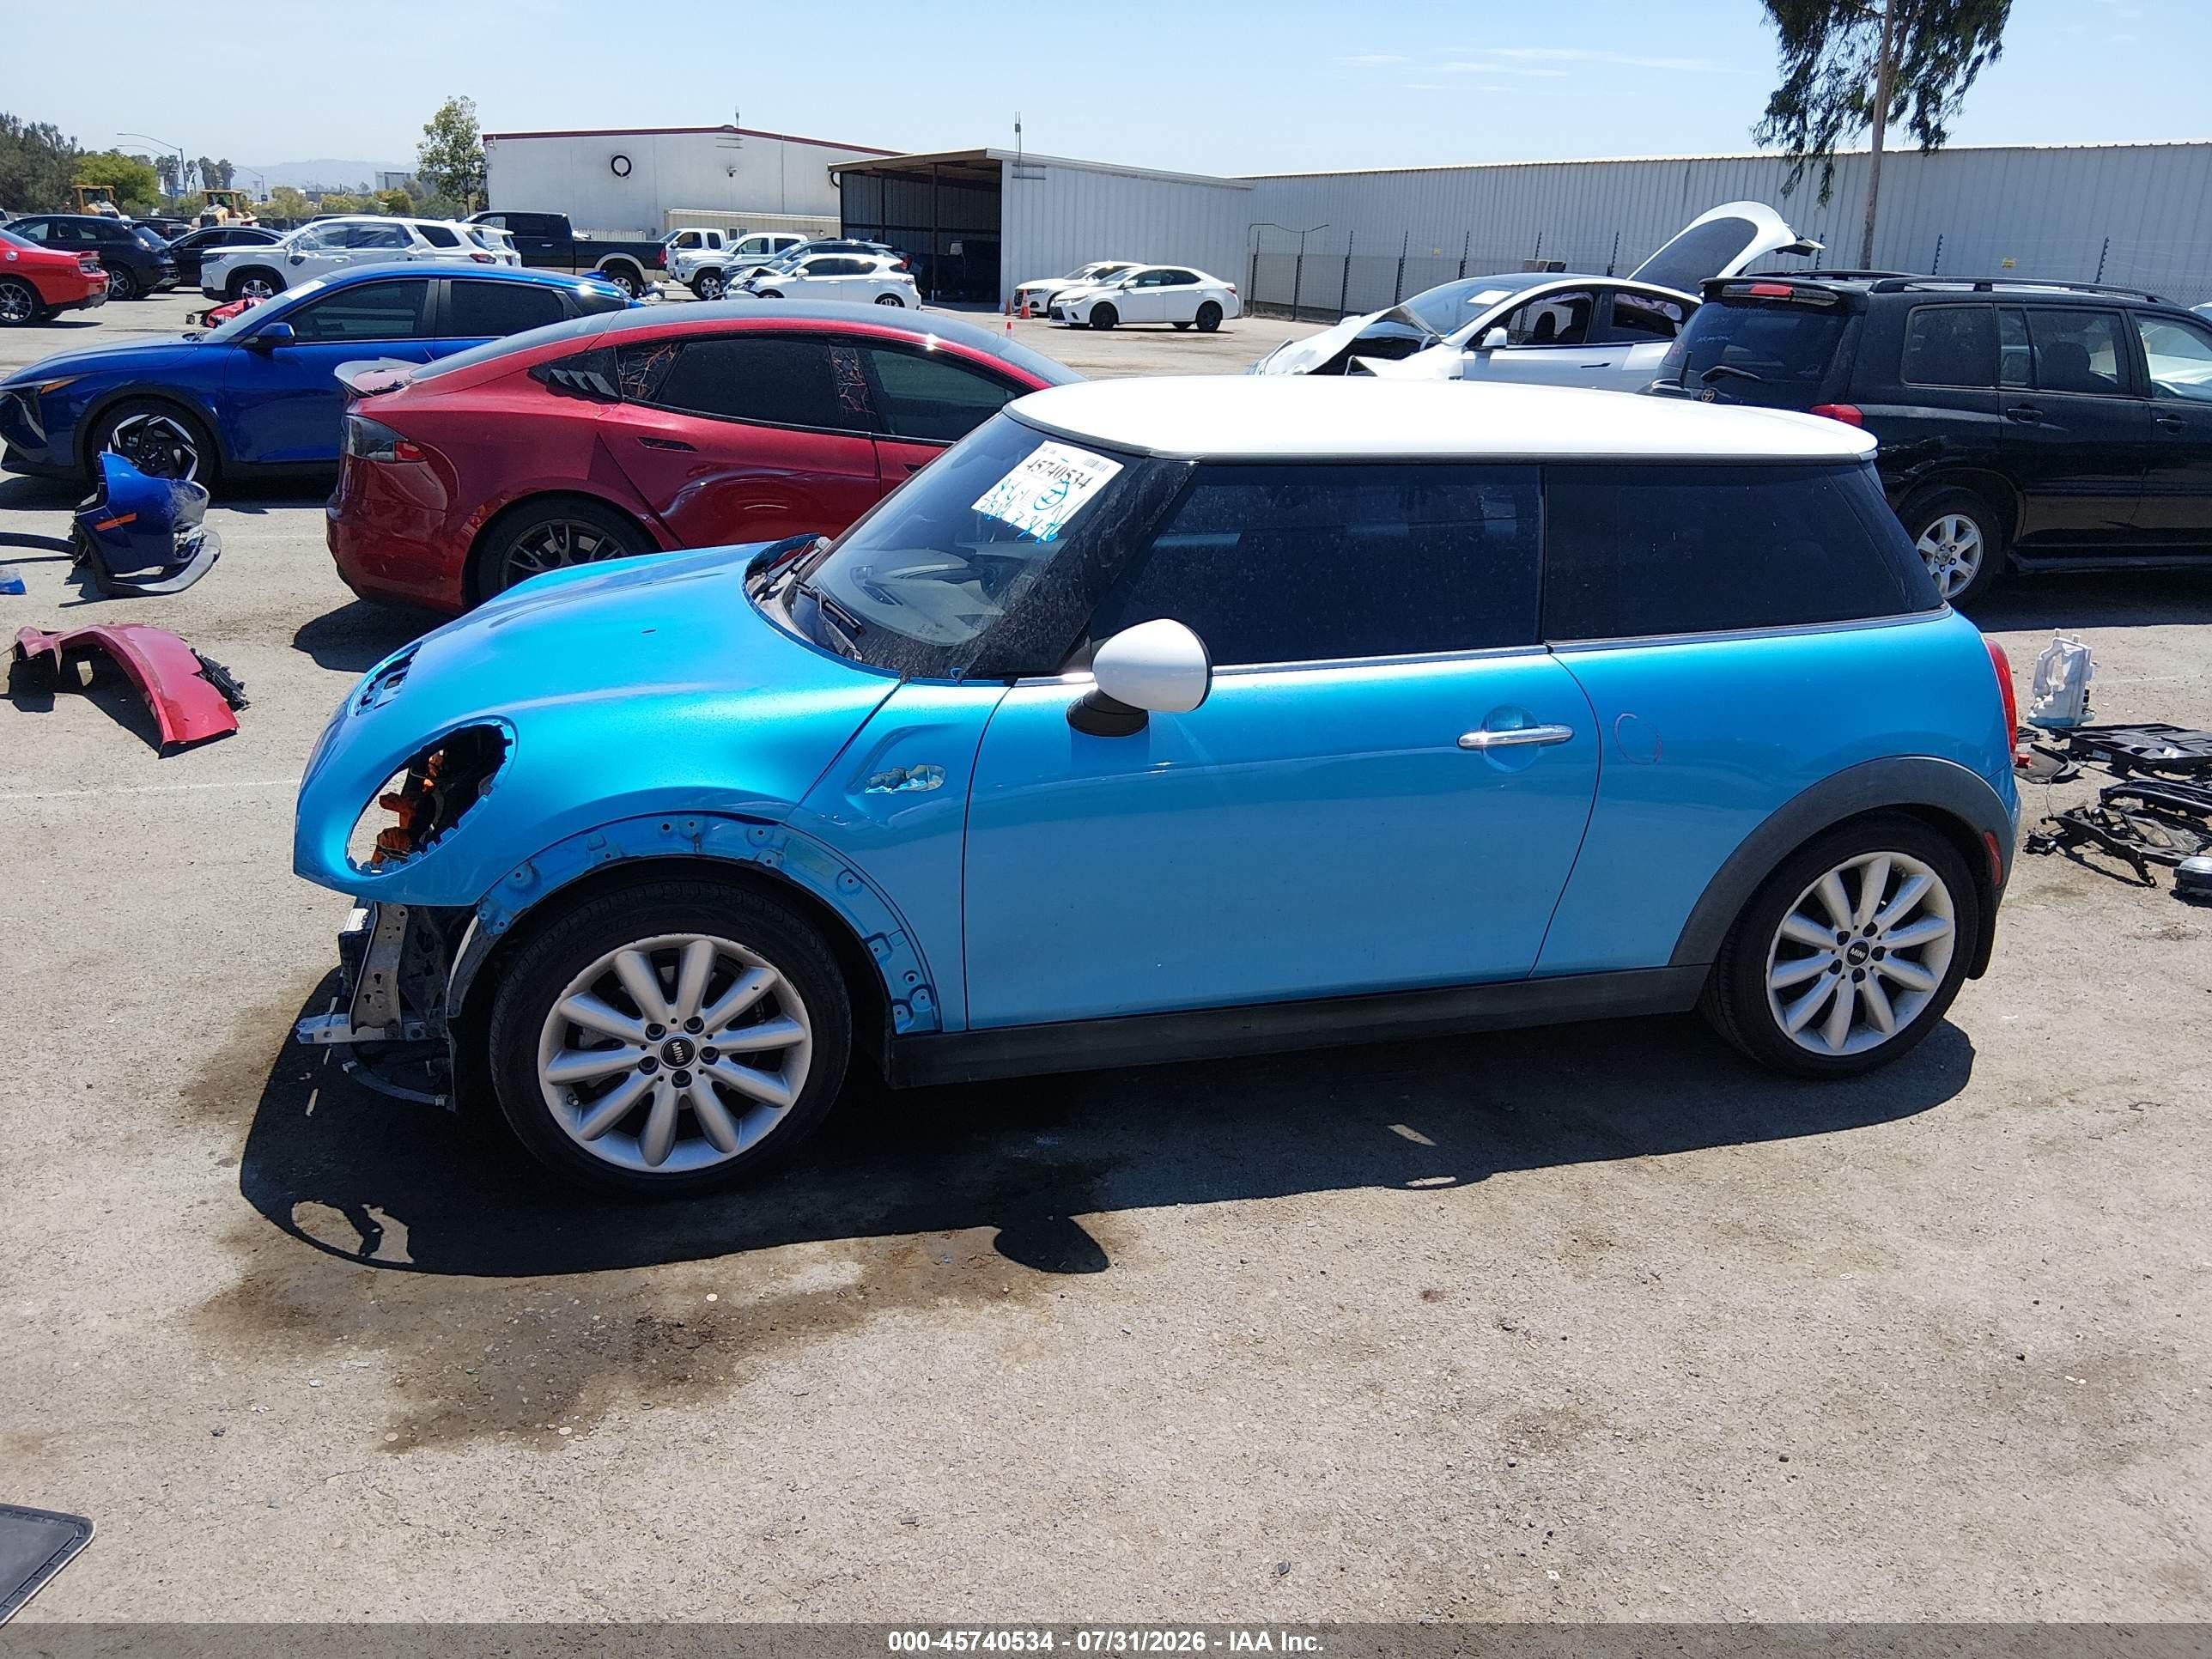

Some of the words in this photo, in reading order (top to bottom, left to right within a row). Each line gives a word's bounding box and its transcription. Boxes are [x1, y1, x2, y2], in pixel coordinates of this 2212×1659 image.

[1026, 458, 1095, 489] 45740534
[1850, 947, 1867, 960] MINI
[671, 1042, 686, 1064] MINI
